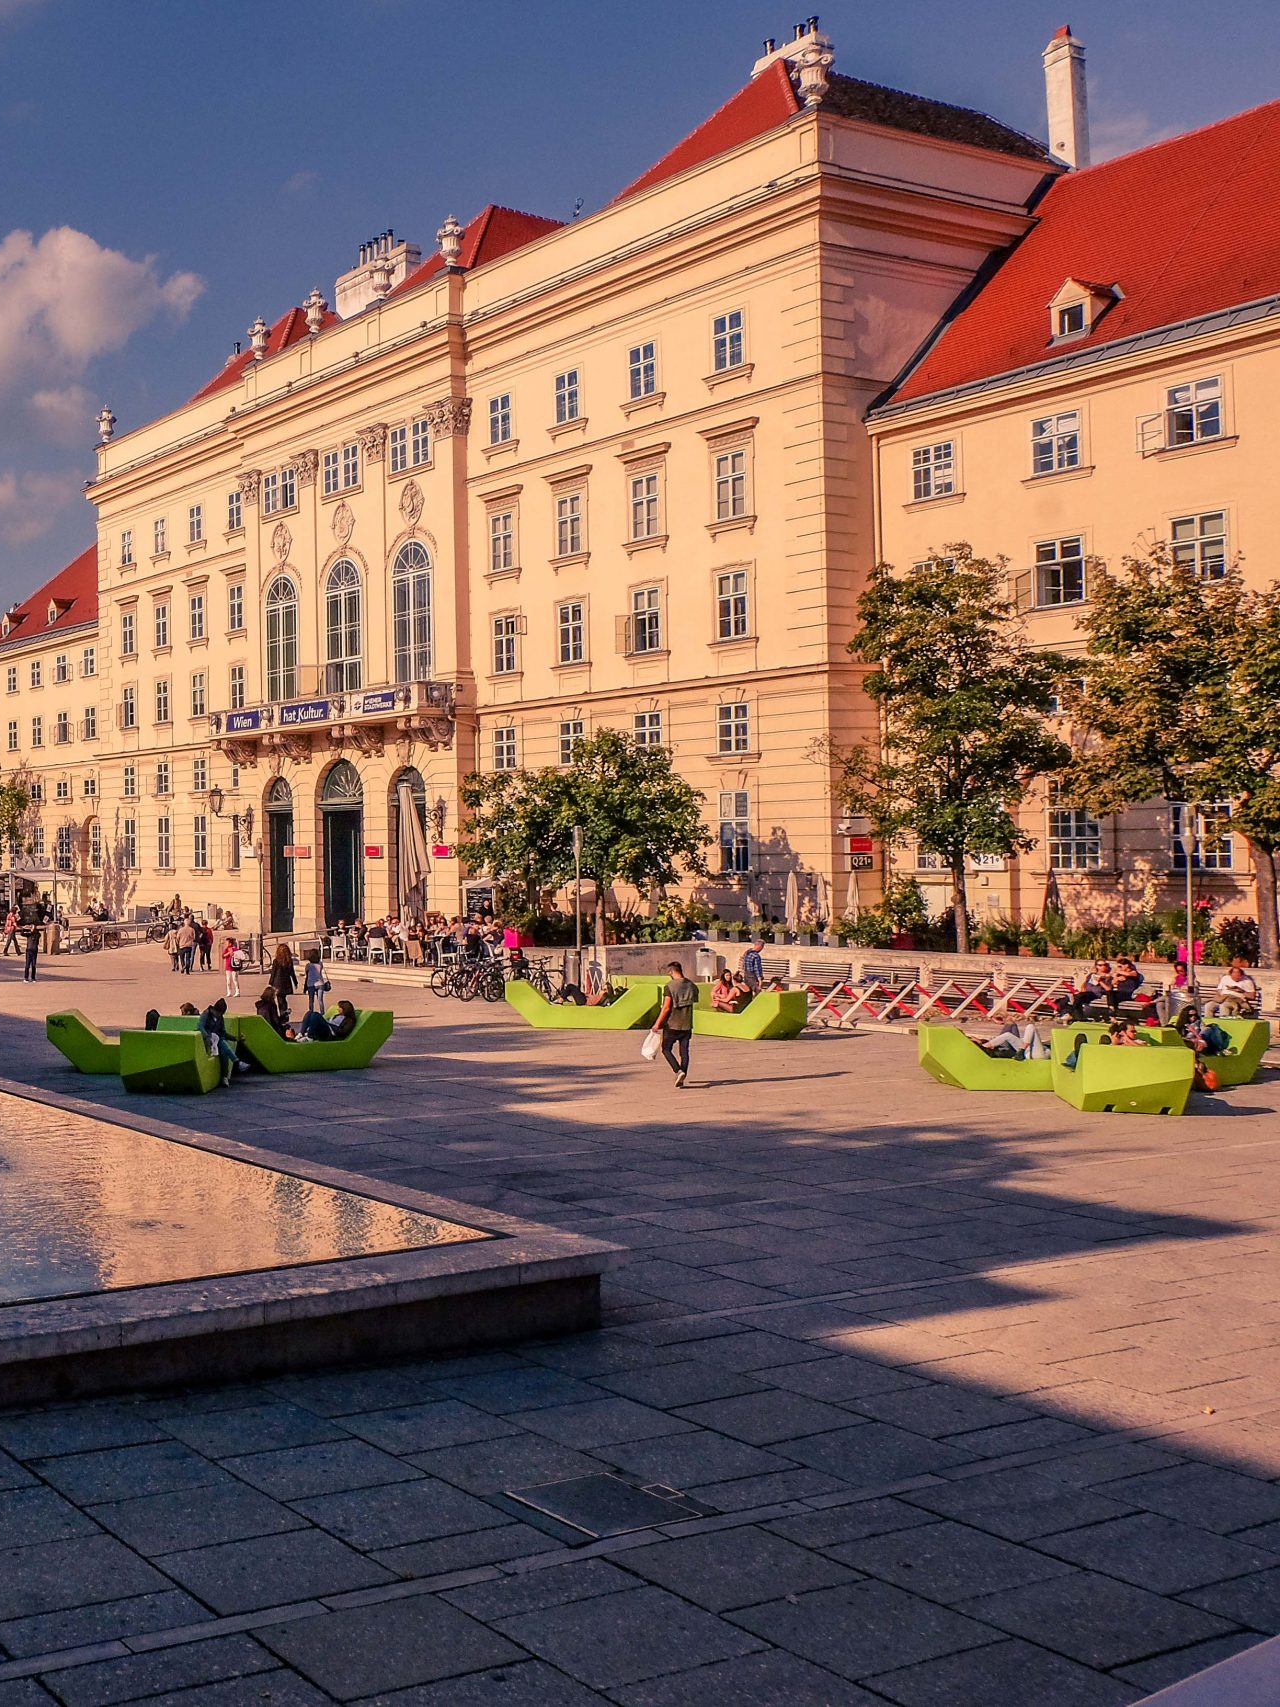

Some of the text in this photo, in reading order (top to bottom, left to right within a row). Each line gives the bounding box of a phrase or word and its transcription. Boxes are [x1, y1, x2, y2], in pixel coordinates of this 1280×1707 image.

[283, 706, 324, 723] hat Kultur.
[233, 716, 253, 729] Wien
